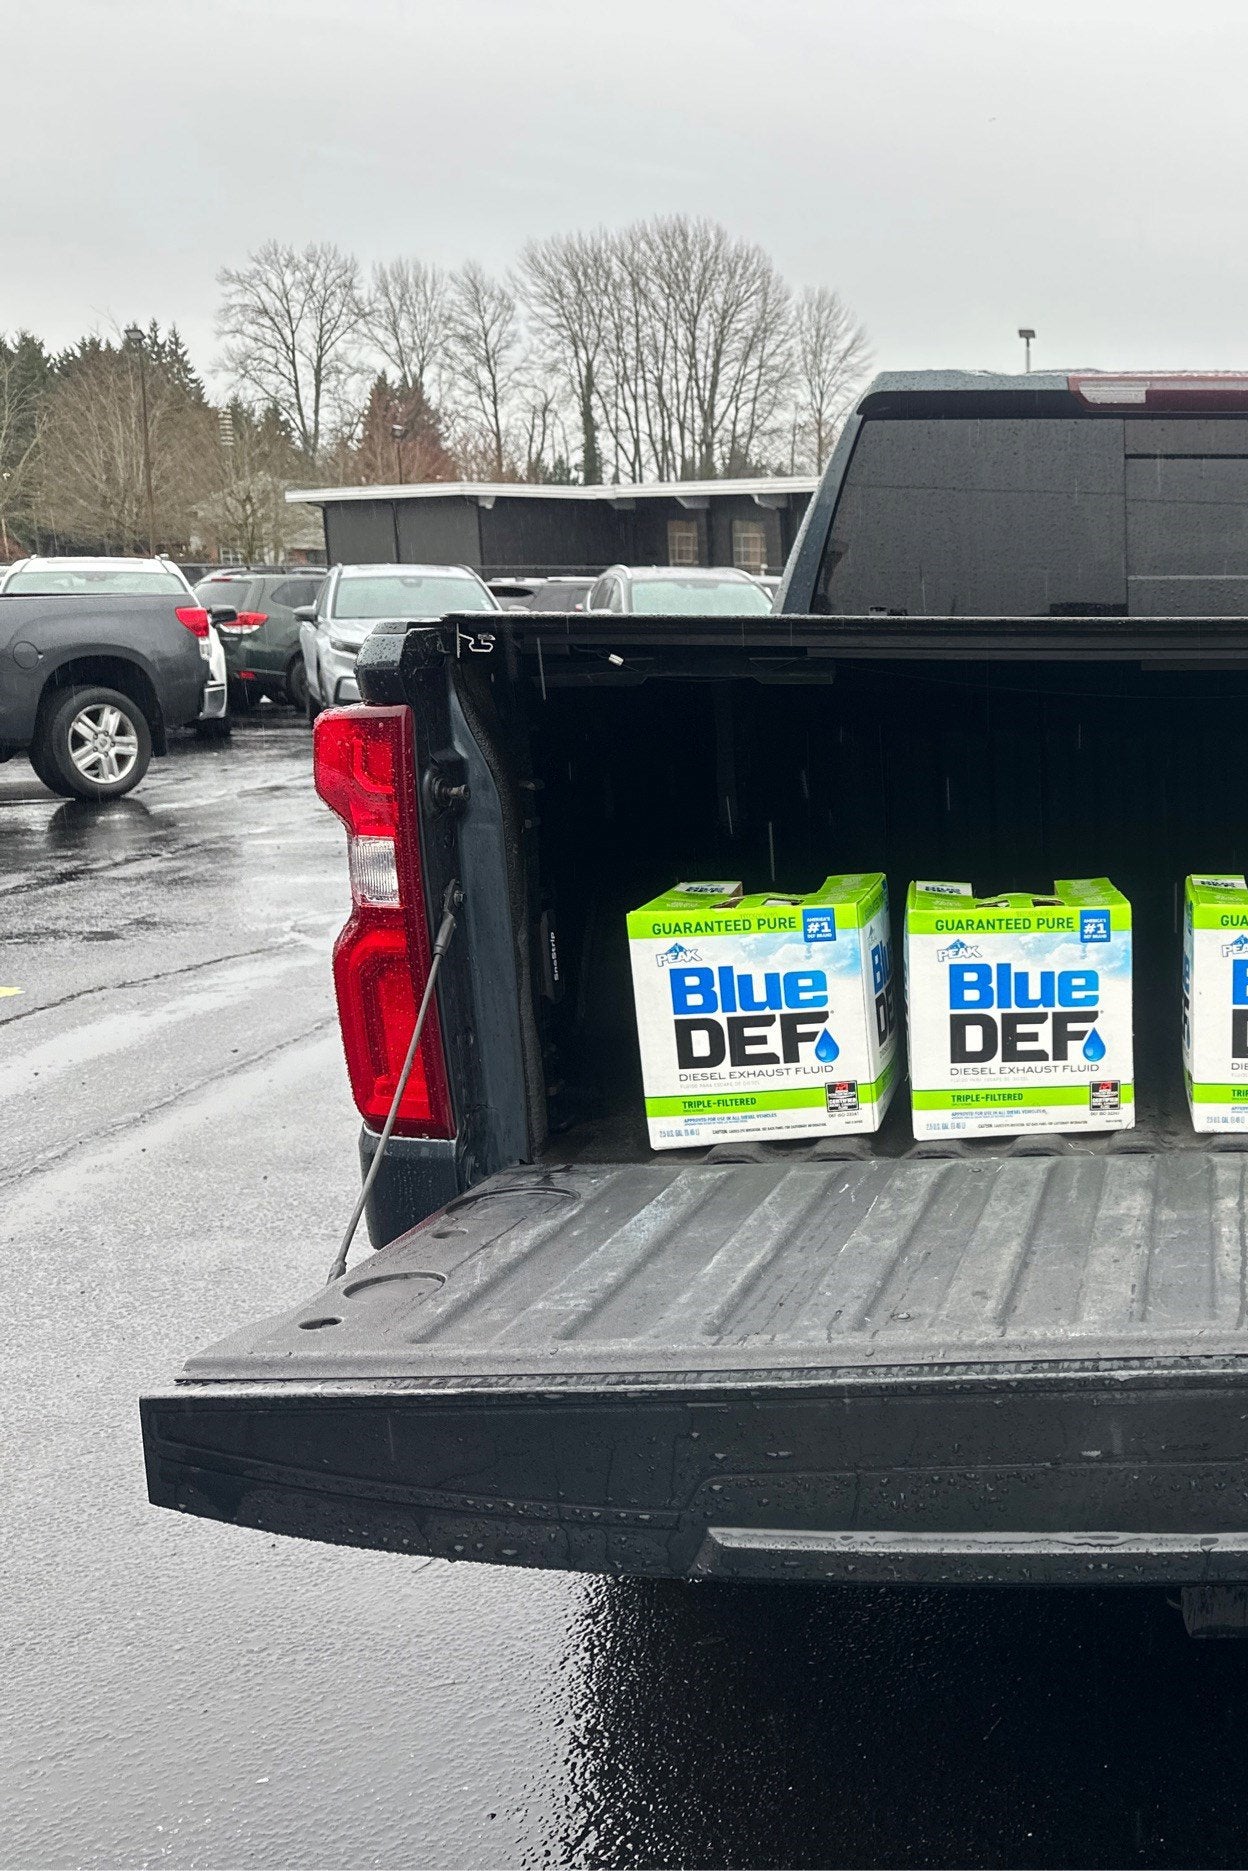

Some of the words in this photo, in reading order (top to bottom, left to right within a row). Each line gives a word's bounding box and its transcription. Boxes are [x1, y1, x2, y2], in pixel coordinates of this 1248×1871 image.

[652, 918, 751, 936] GUARANTEED
[757, 917, 796, 931] PURE
[807, 921, 831, 933] #1
[935, 918, 1031, 931] GUARANTEED
[1037, 917, 1074, 929] PURE
[1083, 923, 1106, 934] #1
[656, 949, 702, 967] PEAK
[937, 945, 982, 962] PEAK
[669, 965, 828, 1015] Blue
[949, 963, 1099, 1010] Blue
[674, 1011, 829, 1069] DEF
[950, 1010, 1099, 1064] DEF
[679, 1073, 726, 1082] DIESEL
[729, 1068, 791, 1079] EXHAUST
[795, 1065, 834, 1075] FLUID
[950, 1066, 996, 1076] DIESEL
[1000, 1065, 1058, 1074] EXHAUST
[1062, 1064, 1099, 1072] FLUID
[682, 1098, 756, 1109] TRIPLE-FILTERED
[951, 1093, 1023, 1102] TRIPLE-FILTERED
